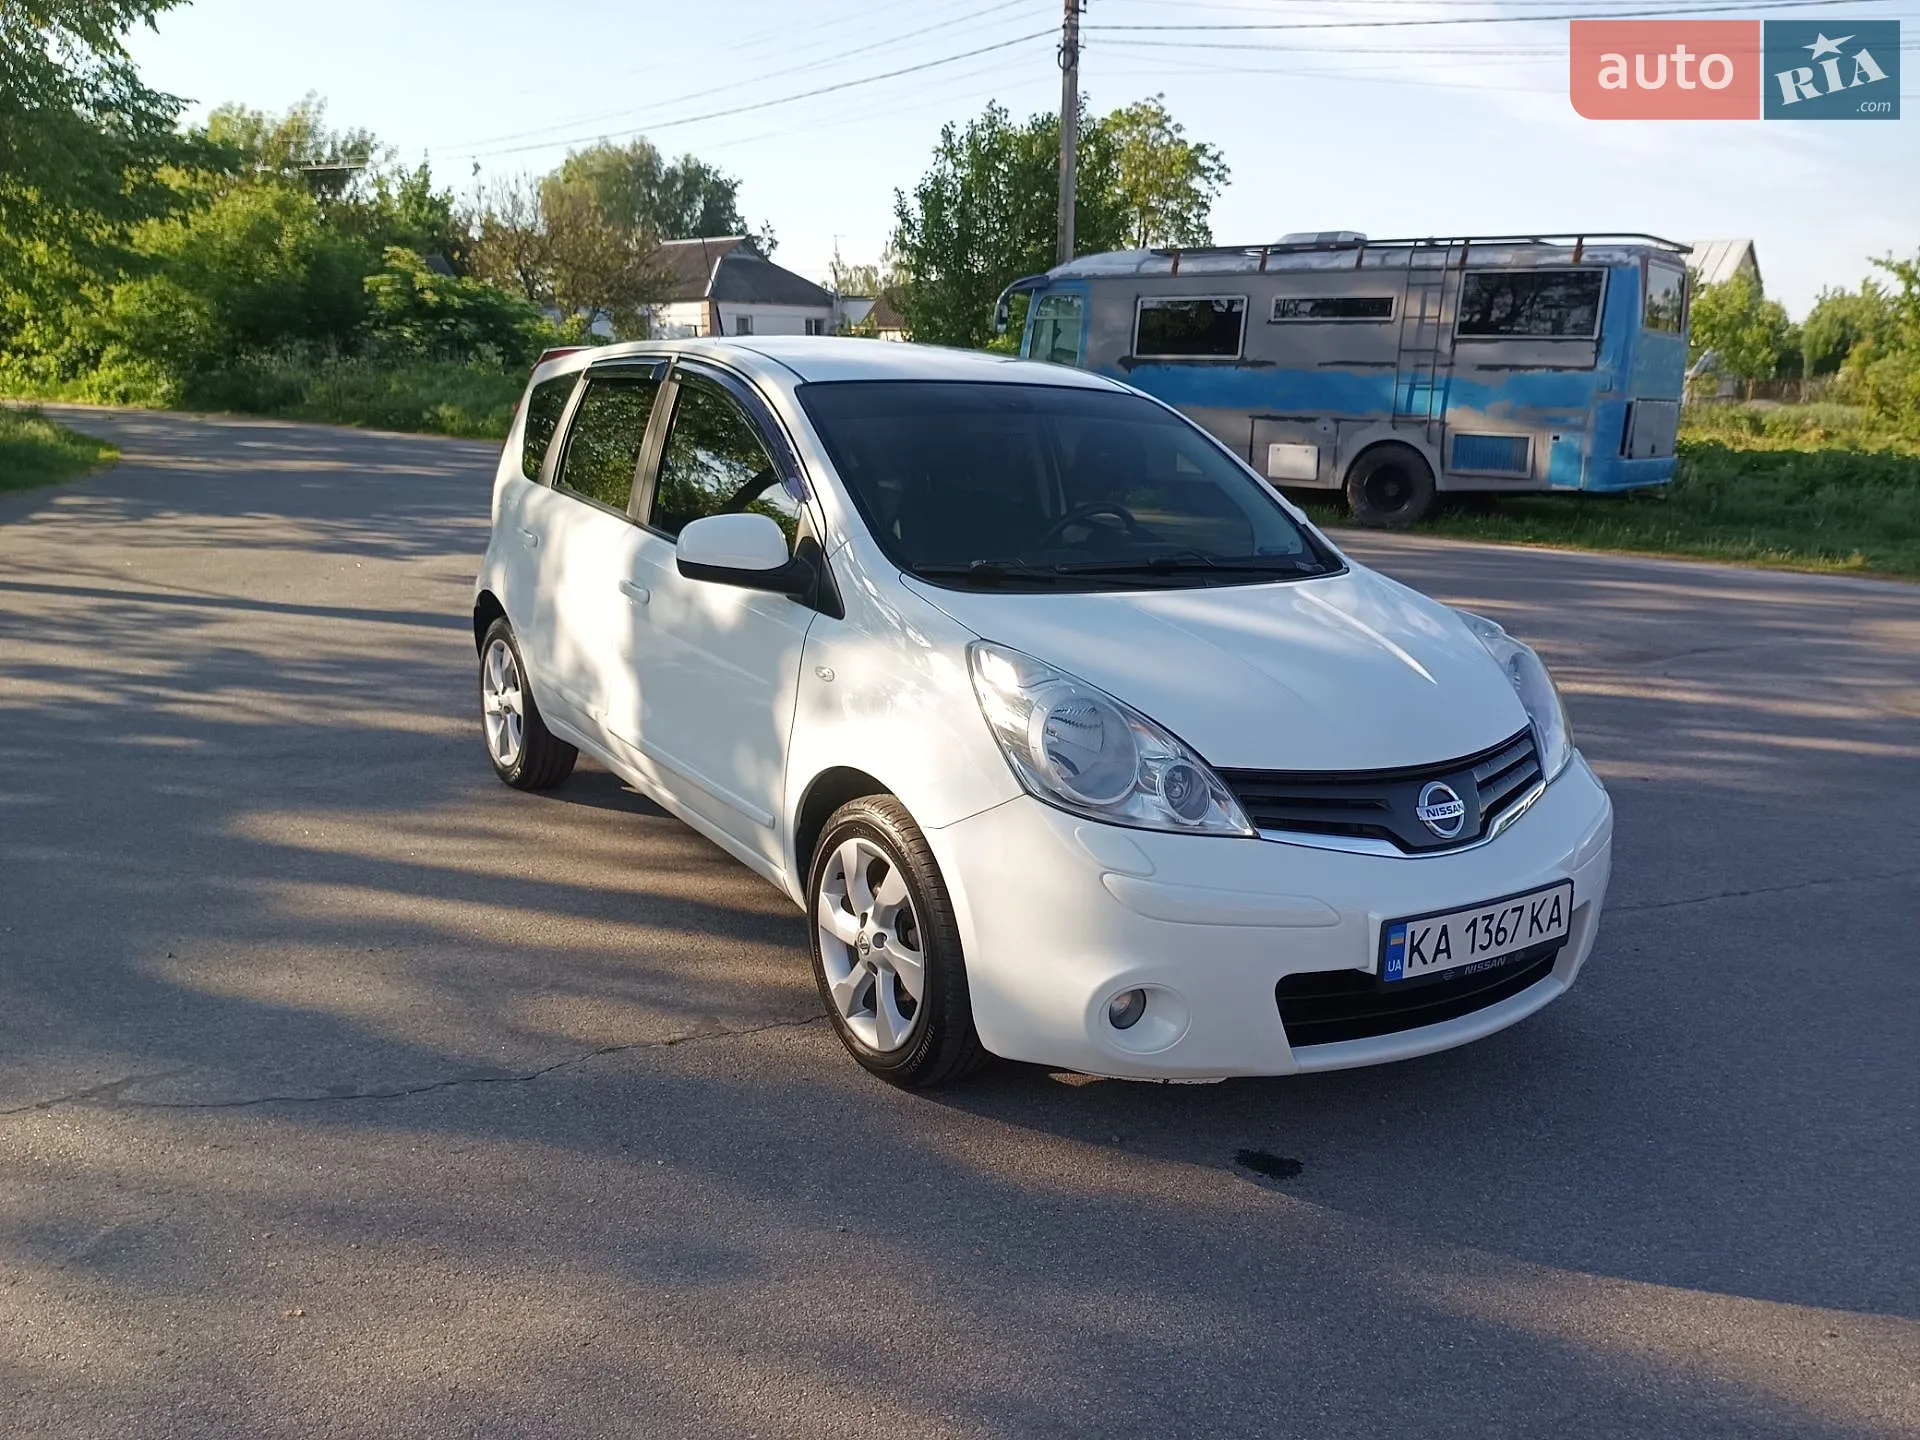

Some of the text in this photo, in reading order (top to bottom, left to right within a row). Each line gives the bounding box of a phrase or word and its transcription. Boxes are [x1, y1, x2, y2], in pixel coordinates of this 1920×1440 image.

[1425, 803, 1463, 818] NISSAN
[1408, 894, 1562, 968] KA 1367 KA
[1387, 960, 1403, 973] UA
[1464, 957, 1506, 976] NISSAN
